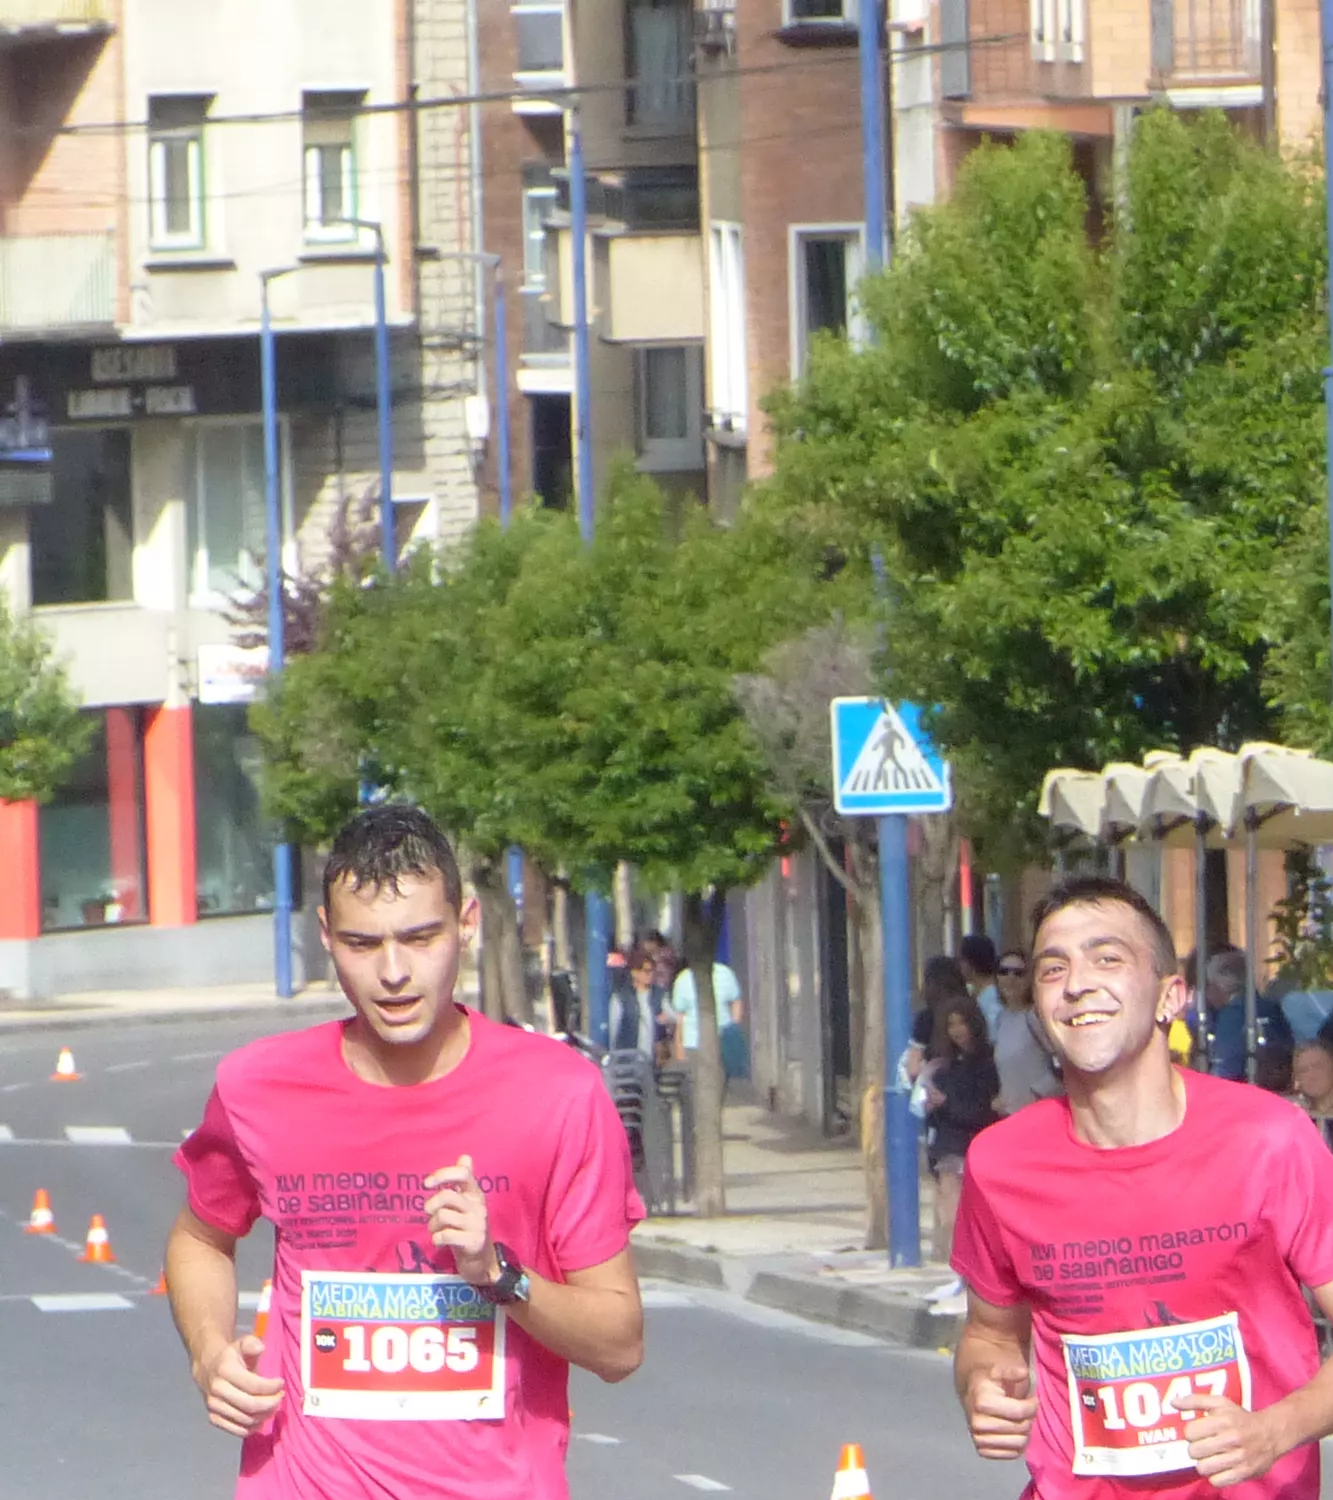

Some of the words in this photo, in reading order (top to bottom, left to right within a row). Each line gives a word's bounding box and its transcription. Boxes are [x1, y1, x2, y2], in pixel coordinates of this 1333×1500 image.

[312, 1284, 378, 1304] MEDIA
[445, 1303, 493, 1319] 2024
[314, 1334, 337, 1348] 10K
[342, 1326, 478, 1373] 1065
[1071, 1346, 1123, 1367] MEDIA
[1129, 1326, 1235, 1361] MARATON
[1191, 1345, 1235, 1368] 2024
[1137, 1427, 1177, 1447] IVAN
